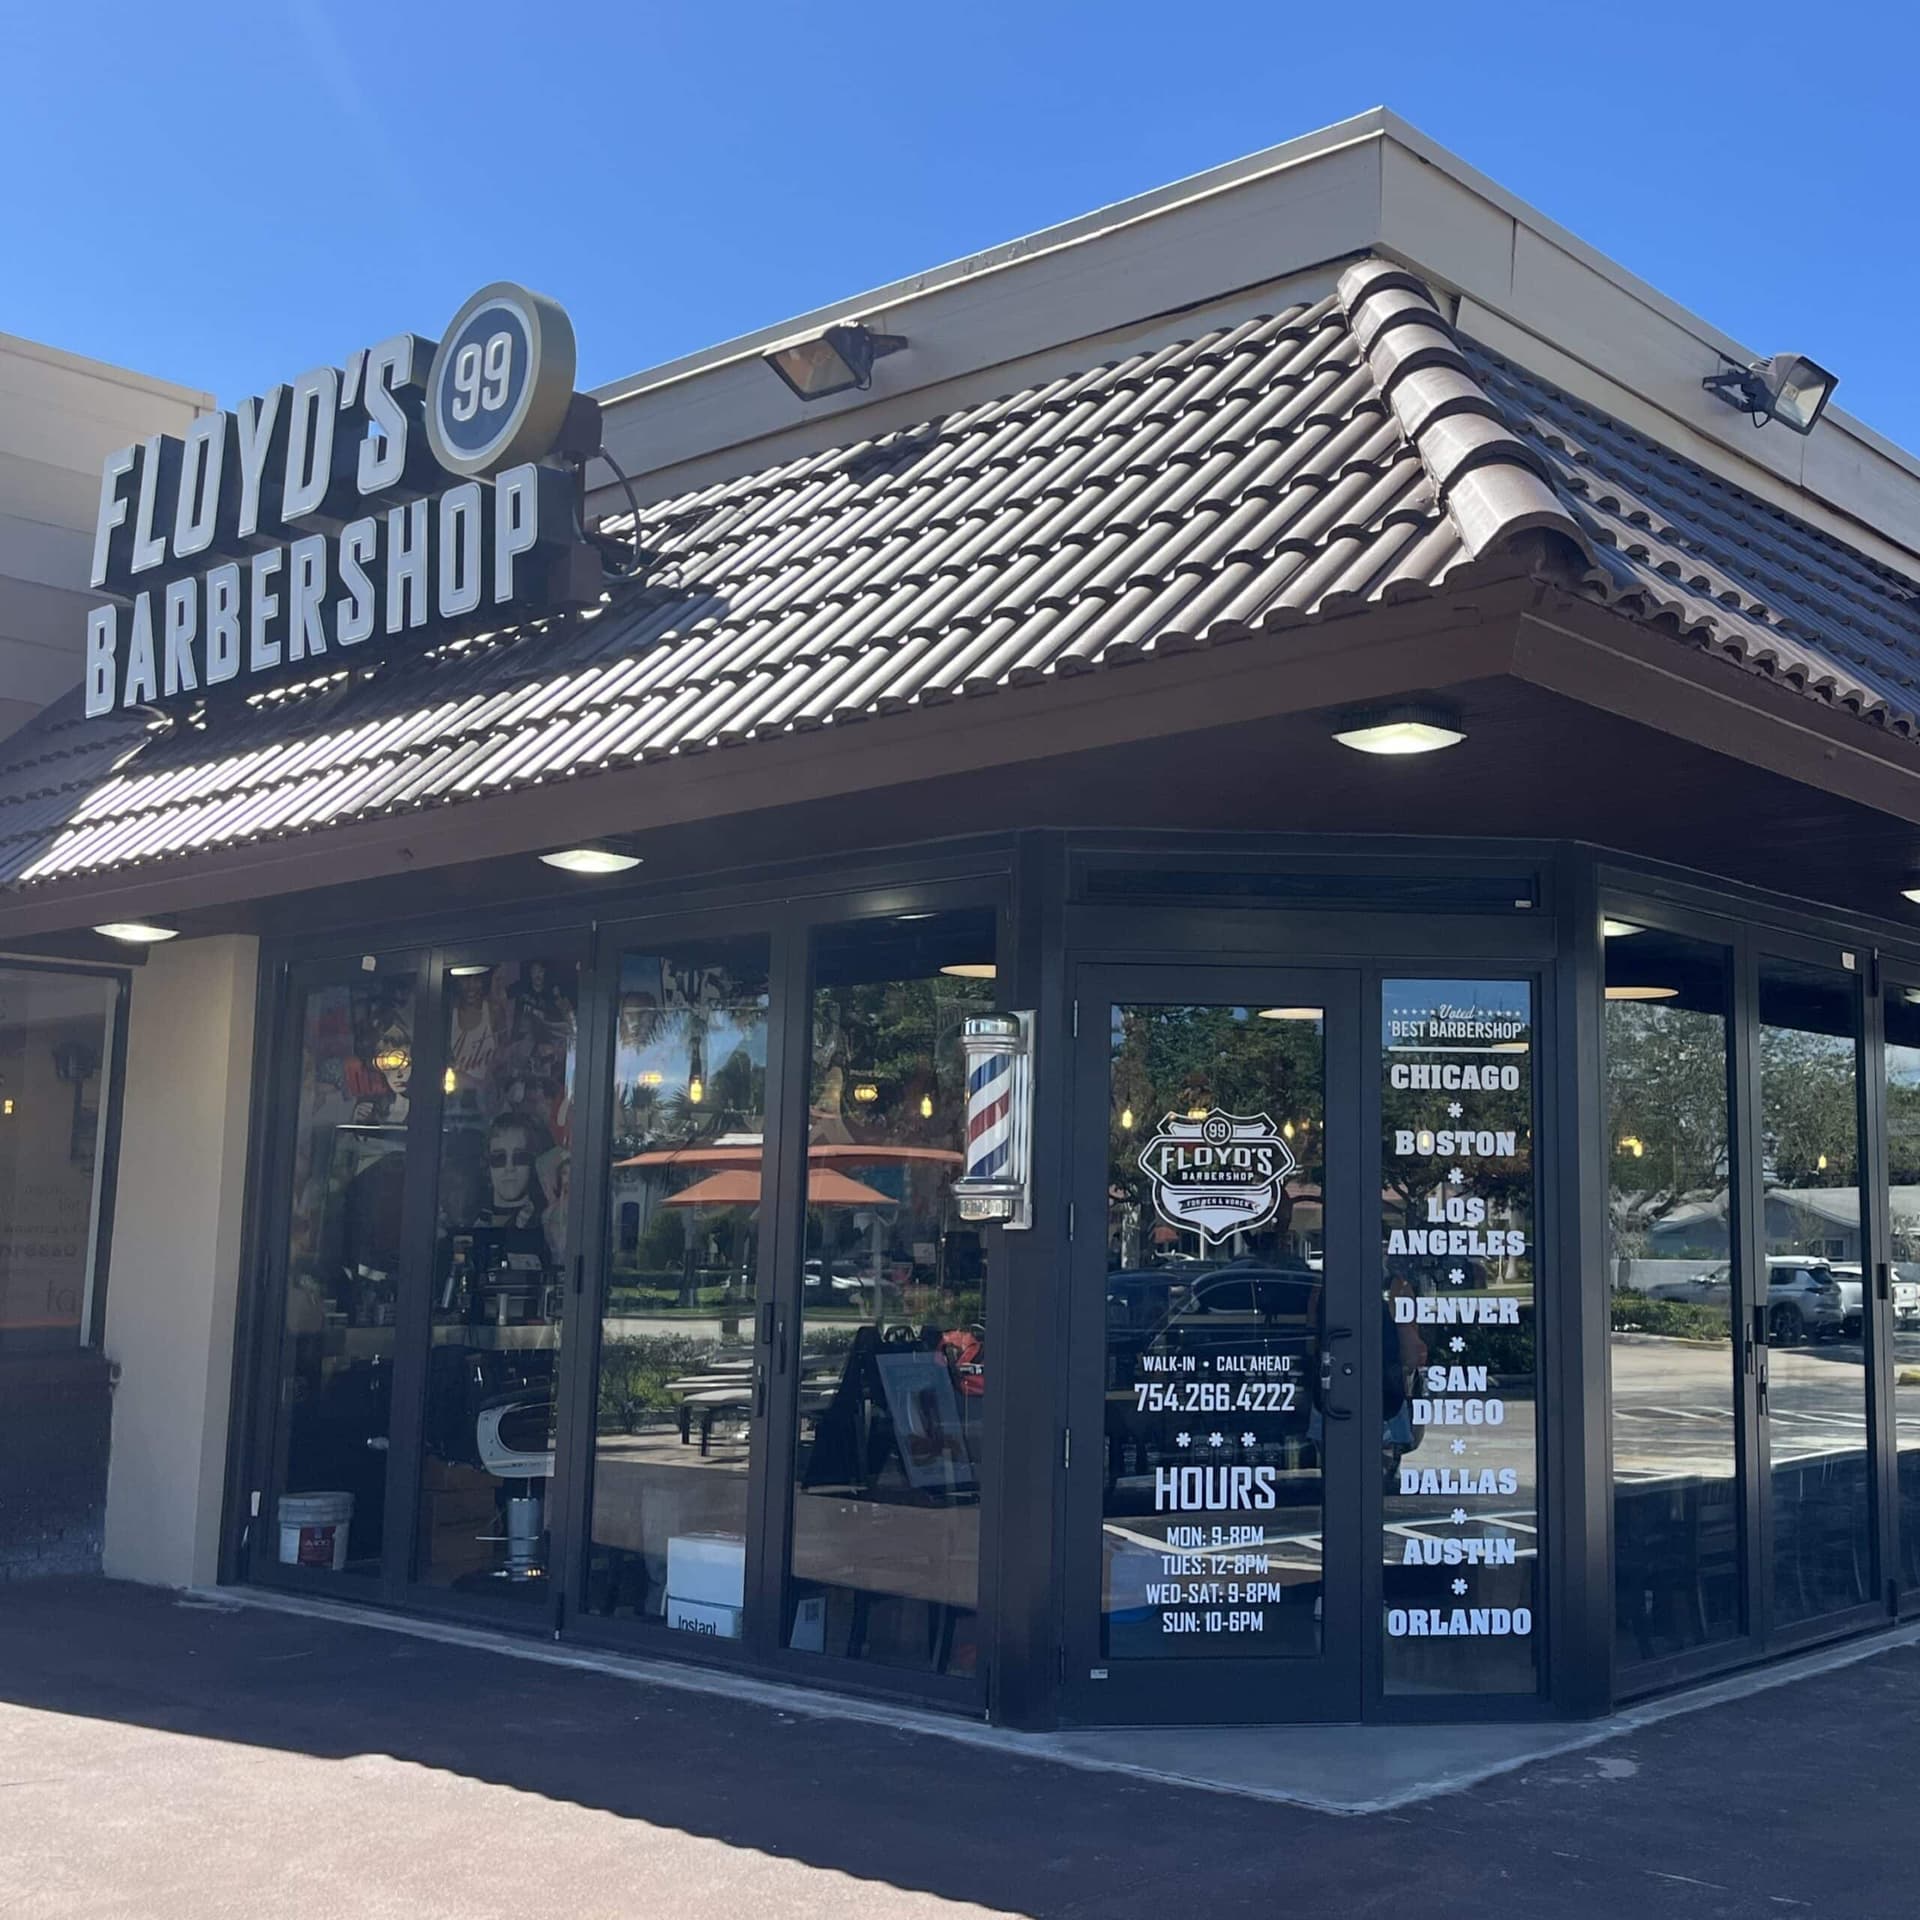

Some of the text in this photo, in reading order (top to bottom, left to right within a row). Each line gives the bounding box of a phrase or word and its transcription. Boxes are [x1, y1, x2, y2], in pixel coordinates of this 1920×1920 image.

[450, 331, 513, 423] 99
[90, 333, 415, 589] FLOYD'S
[85, 462, 538, 719] BARBERSHOP
[1439, 1004, 1476, 1019] Voted
[1391, 1065, 1520, 1091] CHICAGO
[1208, 1123, 1226, 1138] 99
[1395, 1130, 1516, 1157] BOSTON
[1161, 1147, 1273, 1176] FLOYD'S
[1182, 1172, 1254, 1181] BARBERSHOP
[1428, 1198, 1485, 1223] LOS
[1388, 1230, 1526, 1255] ANGELES
[1395, 1296, 1519, 1324] DENVER
[1143, 1356, 1290, 1372] WALK-IN CALL AHEAD
[1428, 1366, 1487, 1392] SAN
[1134, 1383, 1296, 1411] 754.266.4222
[1412, 1399, 1504, 1425] DIEGO
[1155, 1466, 1277, 1511] HOURS
[1400, 1468, 1518, 1495] DALLAS
[1166, 1526, 1264, 1547] MON: 9-8PM
[1402, 1538, 1516, 1565] AUSTIN
[1161, 1555, 1269, 1576] TUES: 12-8PM
[1145, 1583, 1281, 1605] WED-SAT: 9-8PM
[678, 1615, 716, 1637] Instant
[1162, 1612, 1264, 1633] SUN: 10-6PM
[1387, 1608, 1532, 1636] ORLANDO
